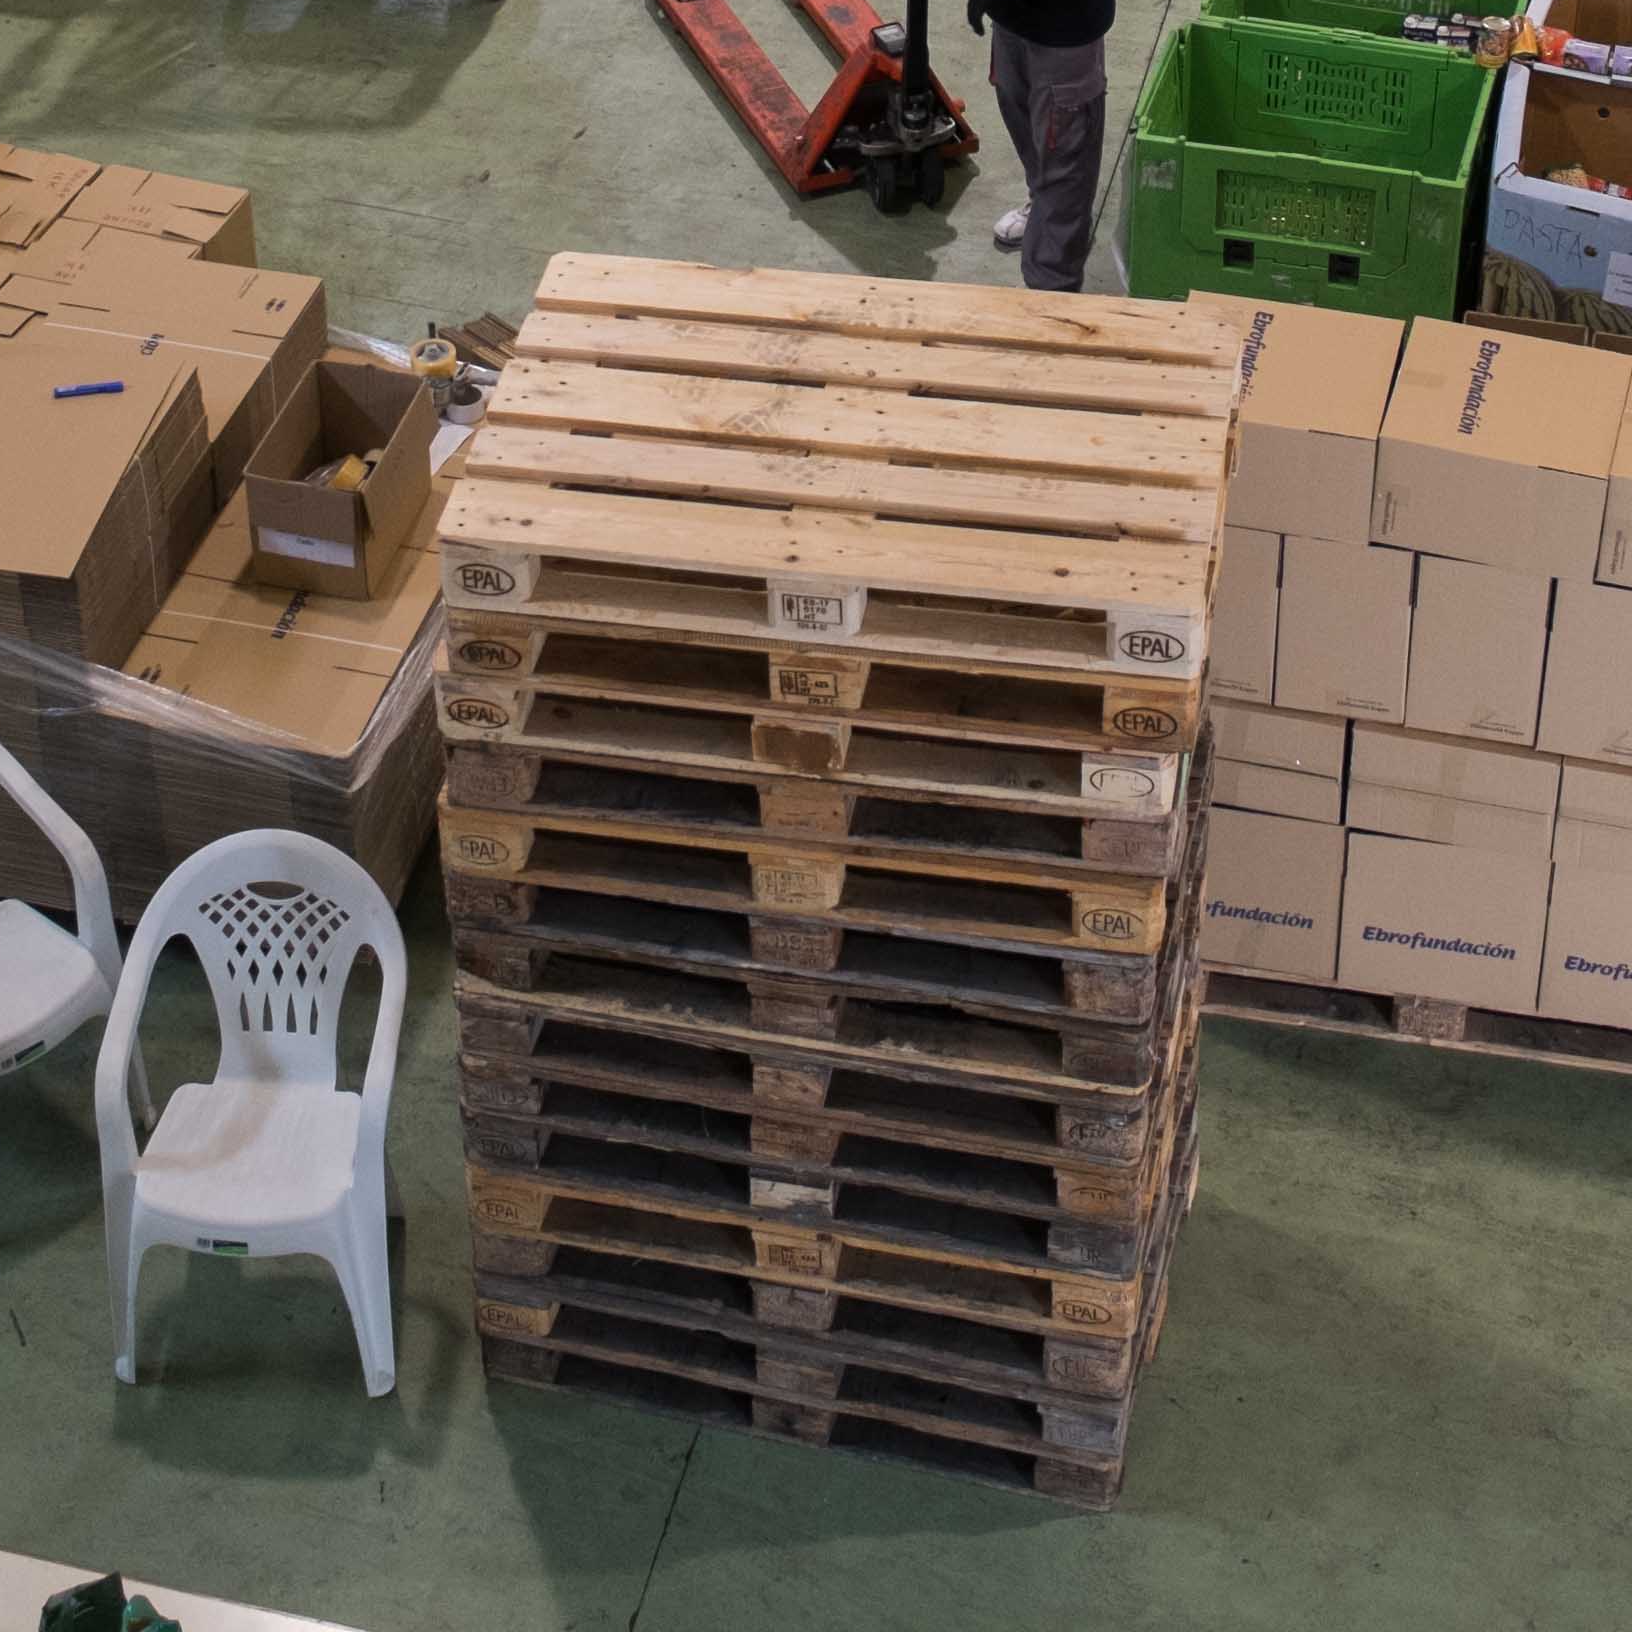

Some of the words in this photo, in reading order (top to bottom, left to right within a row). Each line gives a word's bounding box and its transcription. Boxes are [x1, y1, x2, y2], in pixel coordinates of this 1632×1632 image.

[1503, 209, 1584, 267] PASTA
[1457, 340, 1500, 435] Ebrofundación
[462, 570, 504, 589] EPAL
[1129, 635, 1173, 659] EPAL
[1120, 713, 1165, 734] EPAL
[1206, 901, 1313, 929] fundación
[1362, 926, 1516, 961] Ebrofundación
